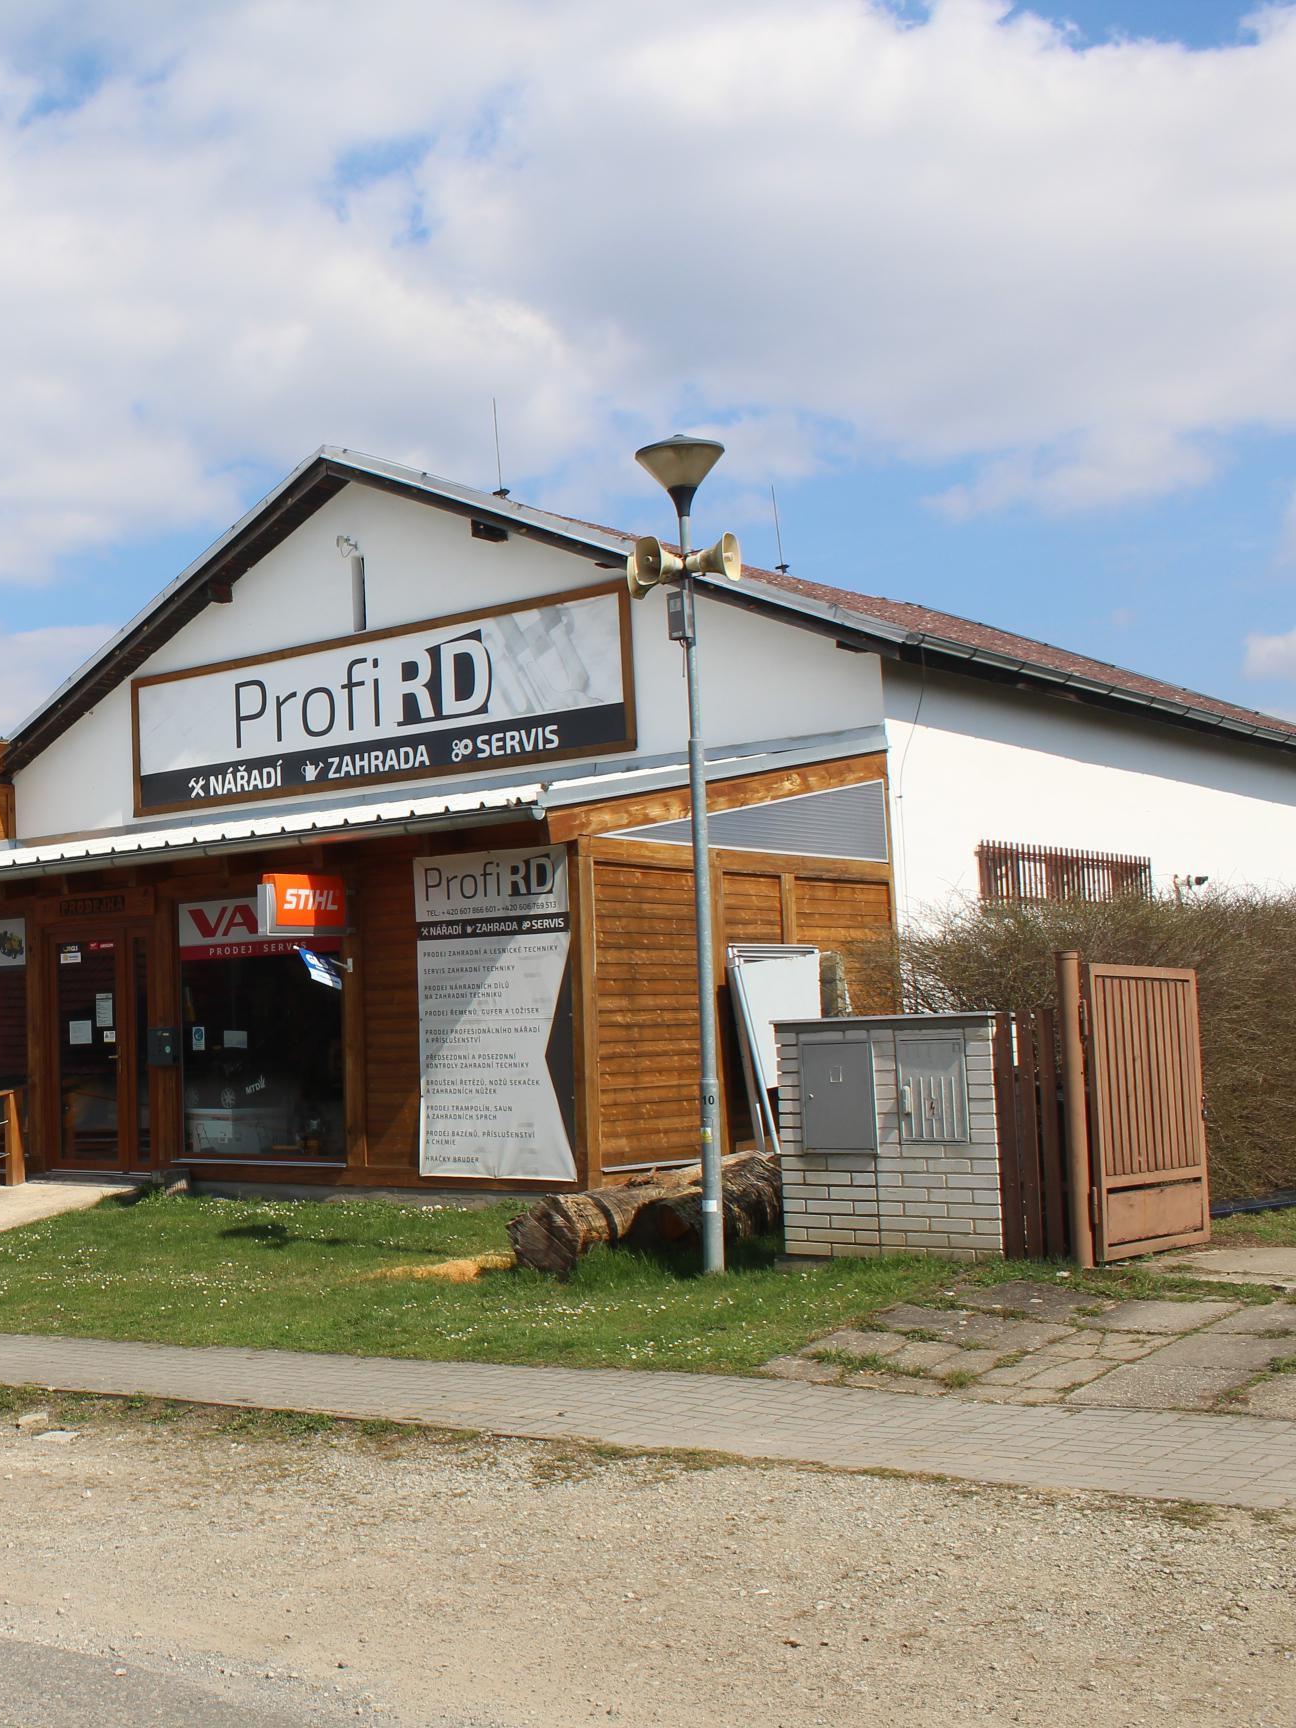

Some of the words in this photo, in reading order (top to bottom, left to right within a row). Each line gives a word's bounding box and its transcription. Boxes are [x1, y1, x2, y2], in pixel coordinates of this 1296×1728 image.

[234, 629, 492, 748] ProfiRD
[209, 760, 282, 796] NÁŘADÍ
[328, 745, 430, 779] ZAHRADA
[476, 725, 559, 758] SERVIS
[424, 853, 554, 901] ProfiRD
[283, 888, 338, 911] STIHL
[188, 904, 258, 938] VA
[430, 923, 462, 935] NÁŘADÍ
[476, 921, 518, 933] ZAHRADA
[531, 918, 564, 930] SERVIS
[209, 946, 252, 956] PRODEJ
[448, 949, 482, 957] ZAHRADNÍ
[524, 945, 558, 953] TECHNIKY
[447, 966, 480, 974] ZAHRADNÍ
[701, 1095, 715, 1105] 10
